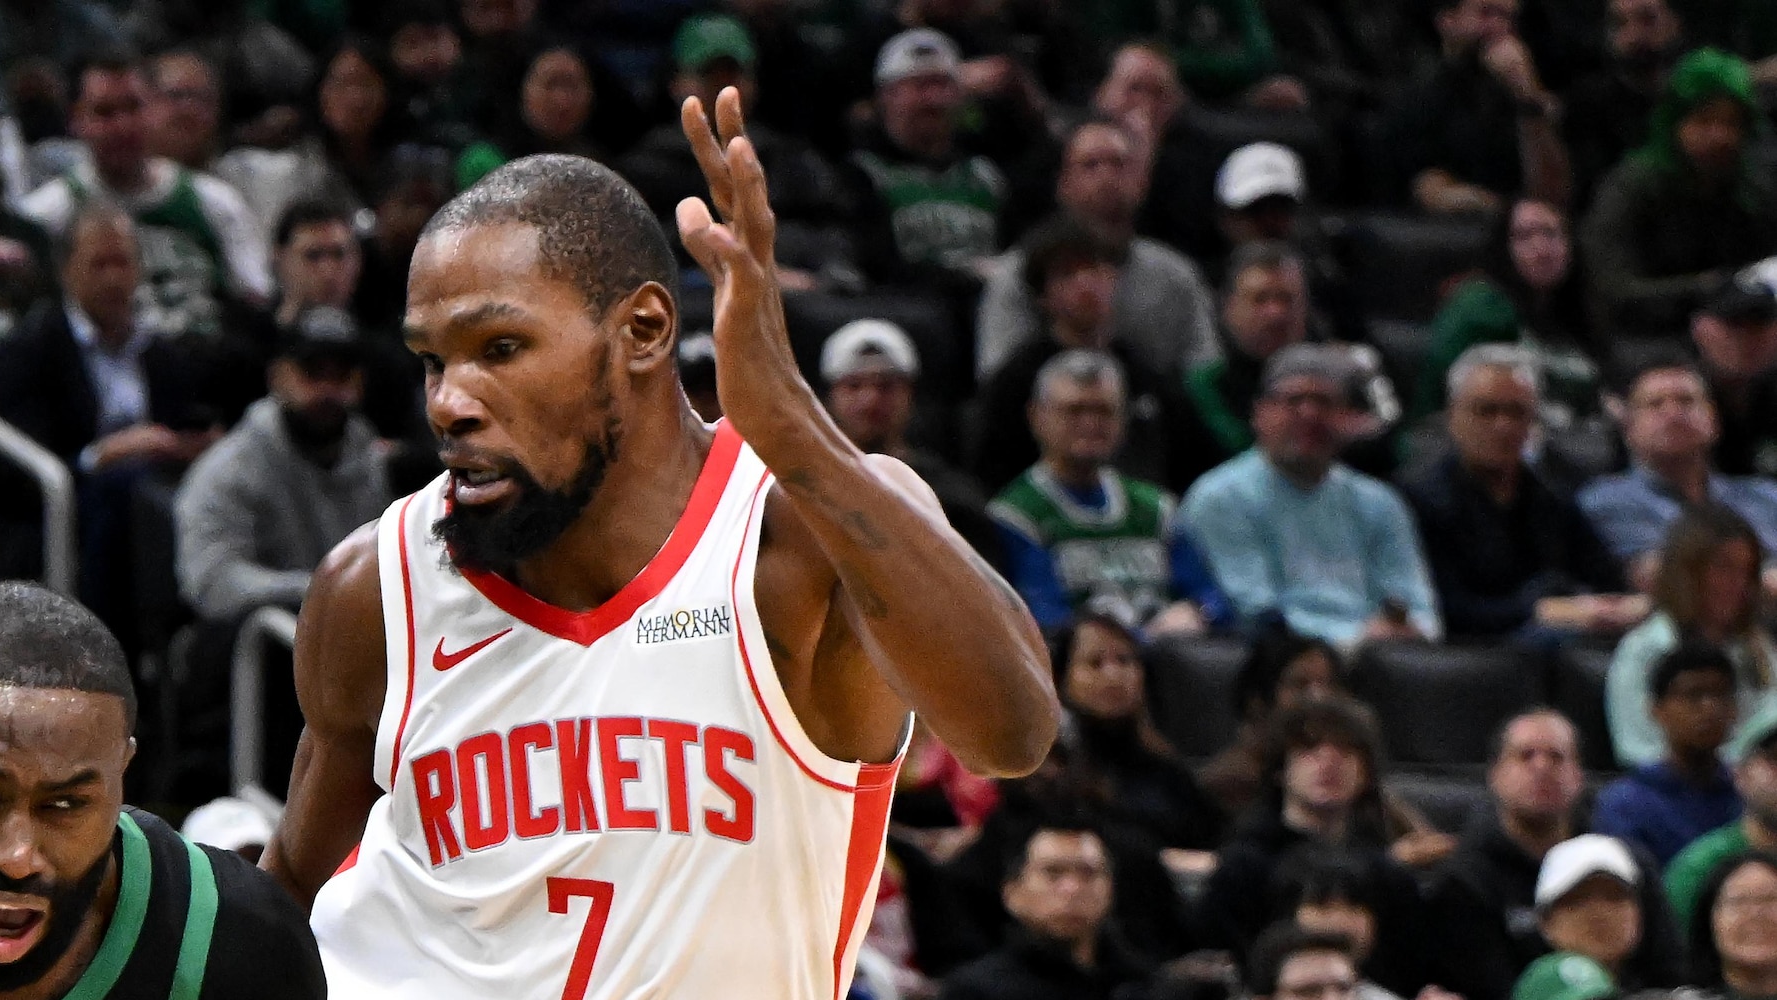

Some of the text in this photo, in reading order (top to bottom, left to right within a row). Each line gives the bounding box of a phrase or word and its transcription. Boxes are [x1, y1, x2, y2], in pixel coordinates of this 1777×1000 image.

[636, 618, 731, 644] HERMANN
[637, 605, 730, 632] MEMORIAL
[409, 715, 758, 871] ROCKETS
